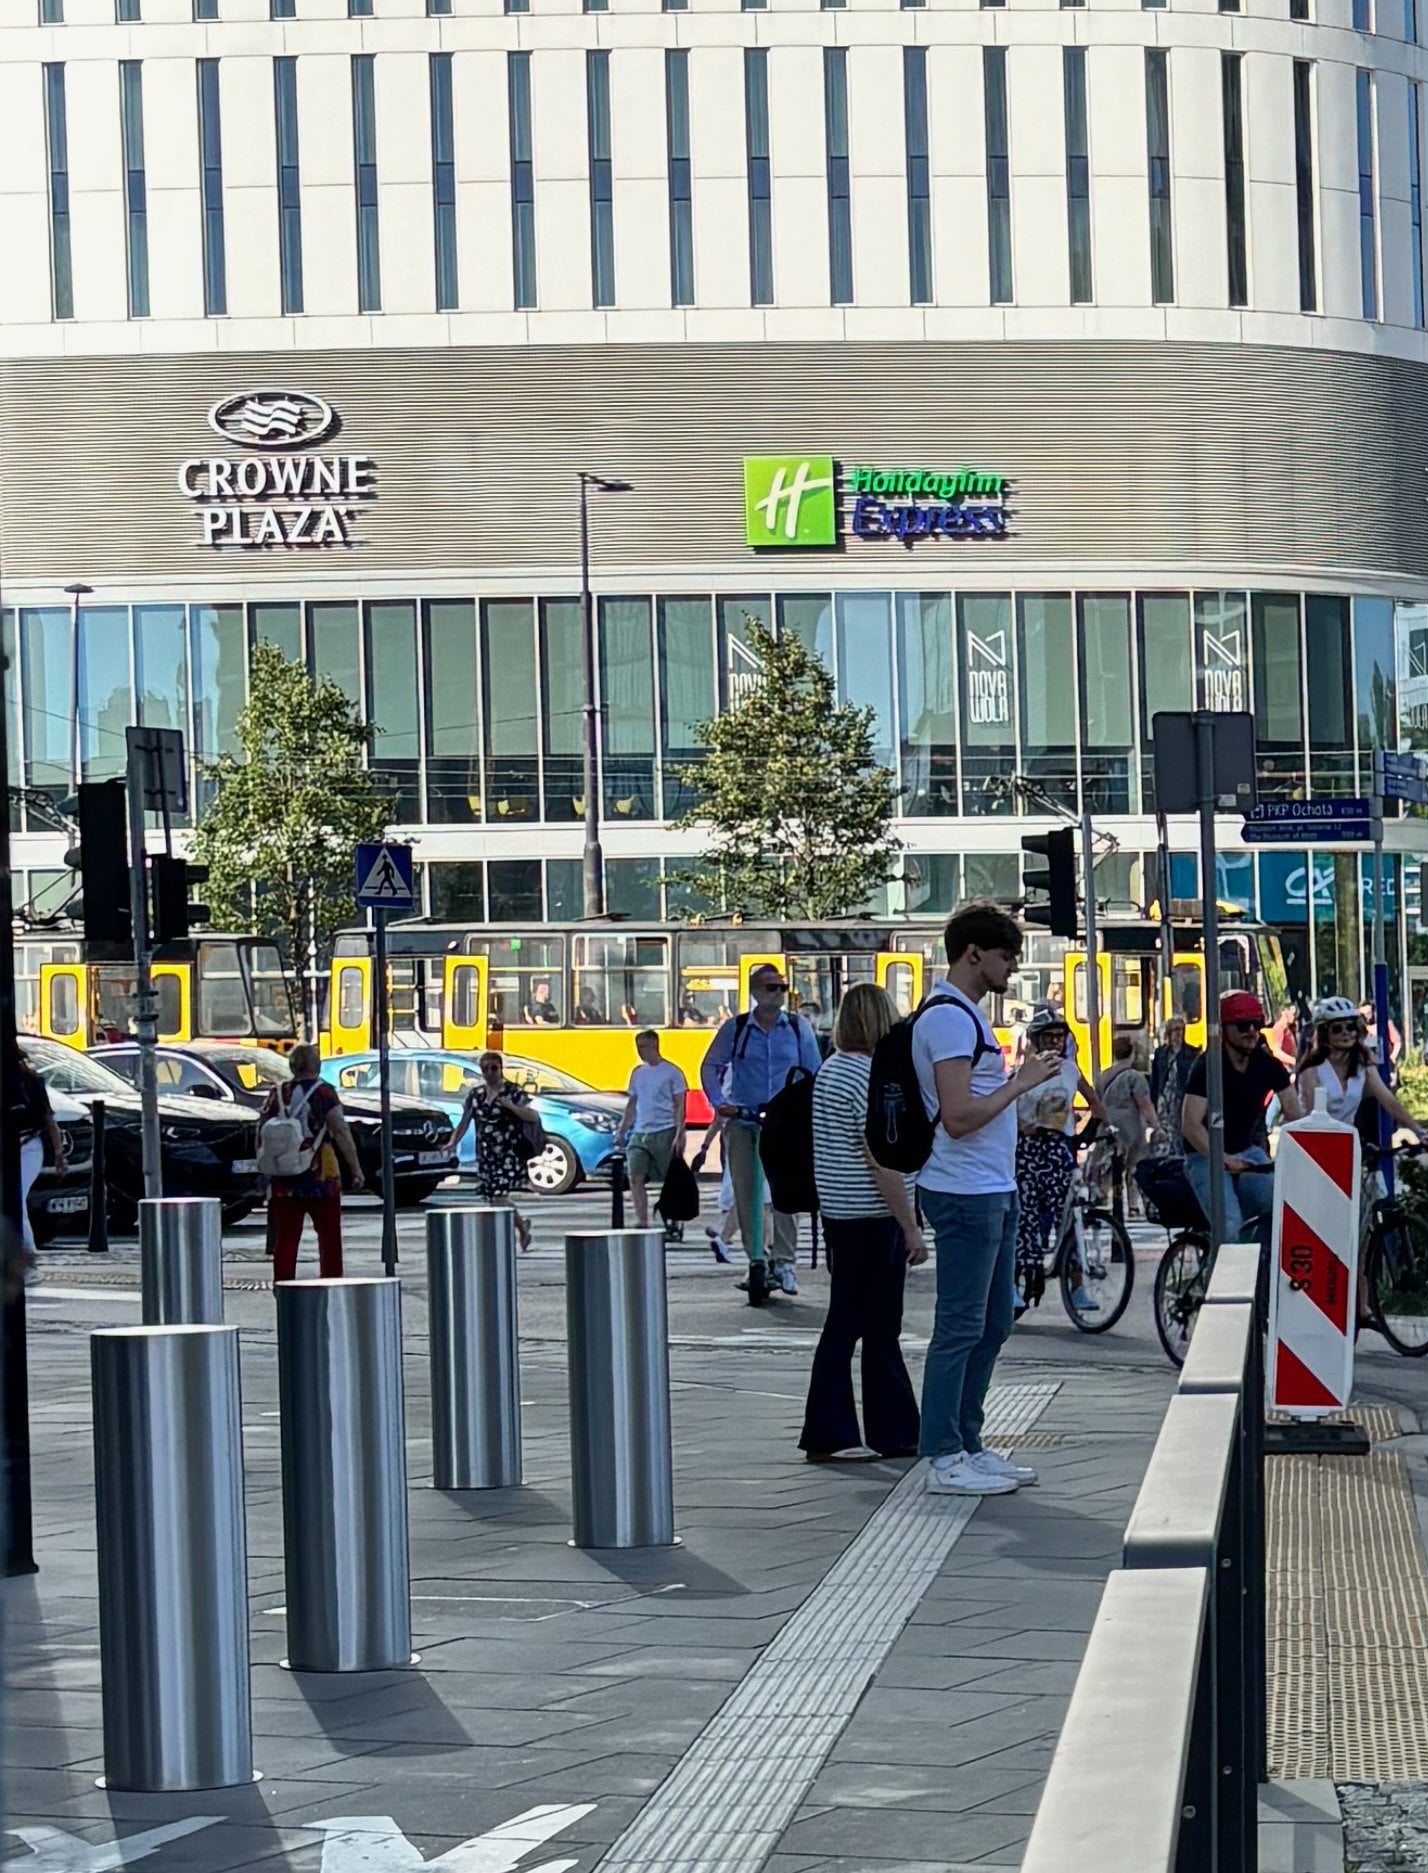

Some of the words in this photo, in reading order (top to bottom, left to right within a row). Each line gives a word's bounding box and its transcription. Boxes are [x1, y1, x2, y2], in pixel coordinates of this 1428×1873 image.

[178, 455, 369, 497] CROWNE
[202, 505, 347, 545] PLAZA
[852, 496, 1004, 538] Express
[1292, 801, 1334, 816] Ochota
[1289, 1244, 1312, 1274] 30
